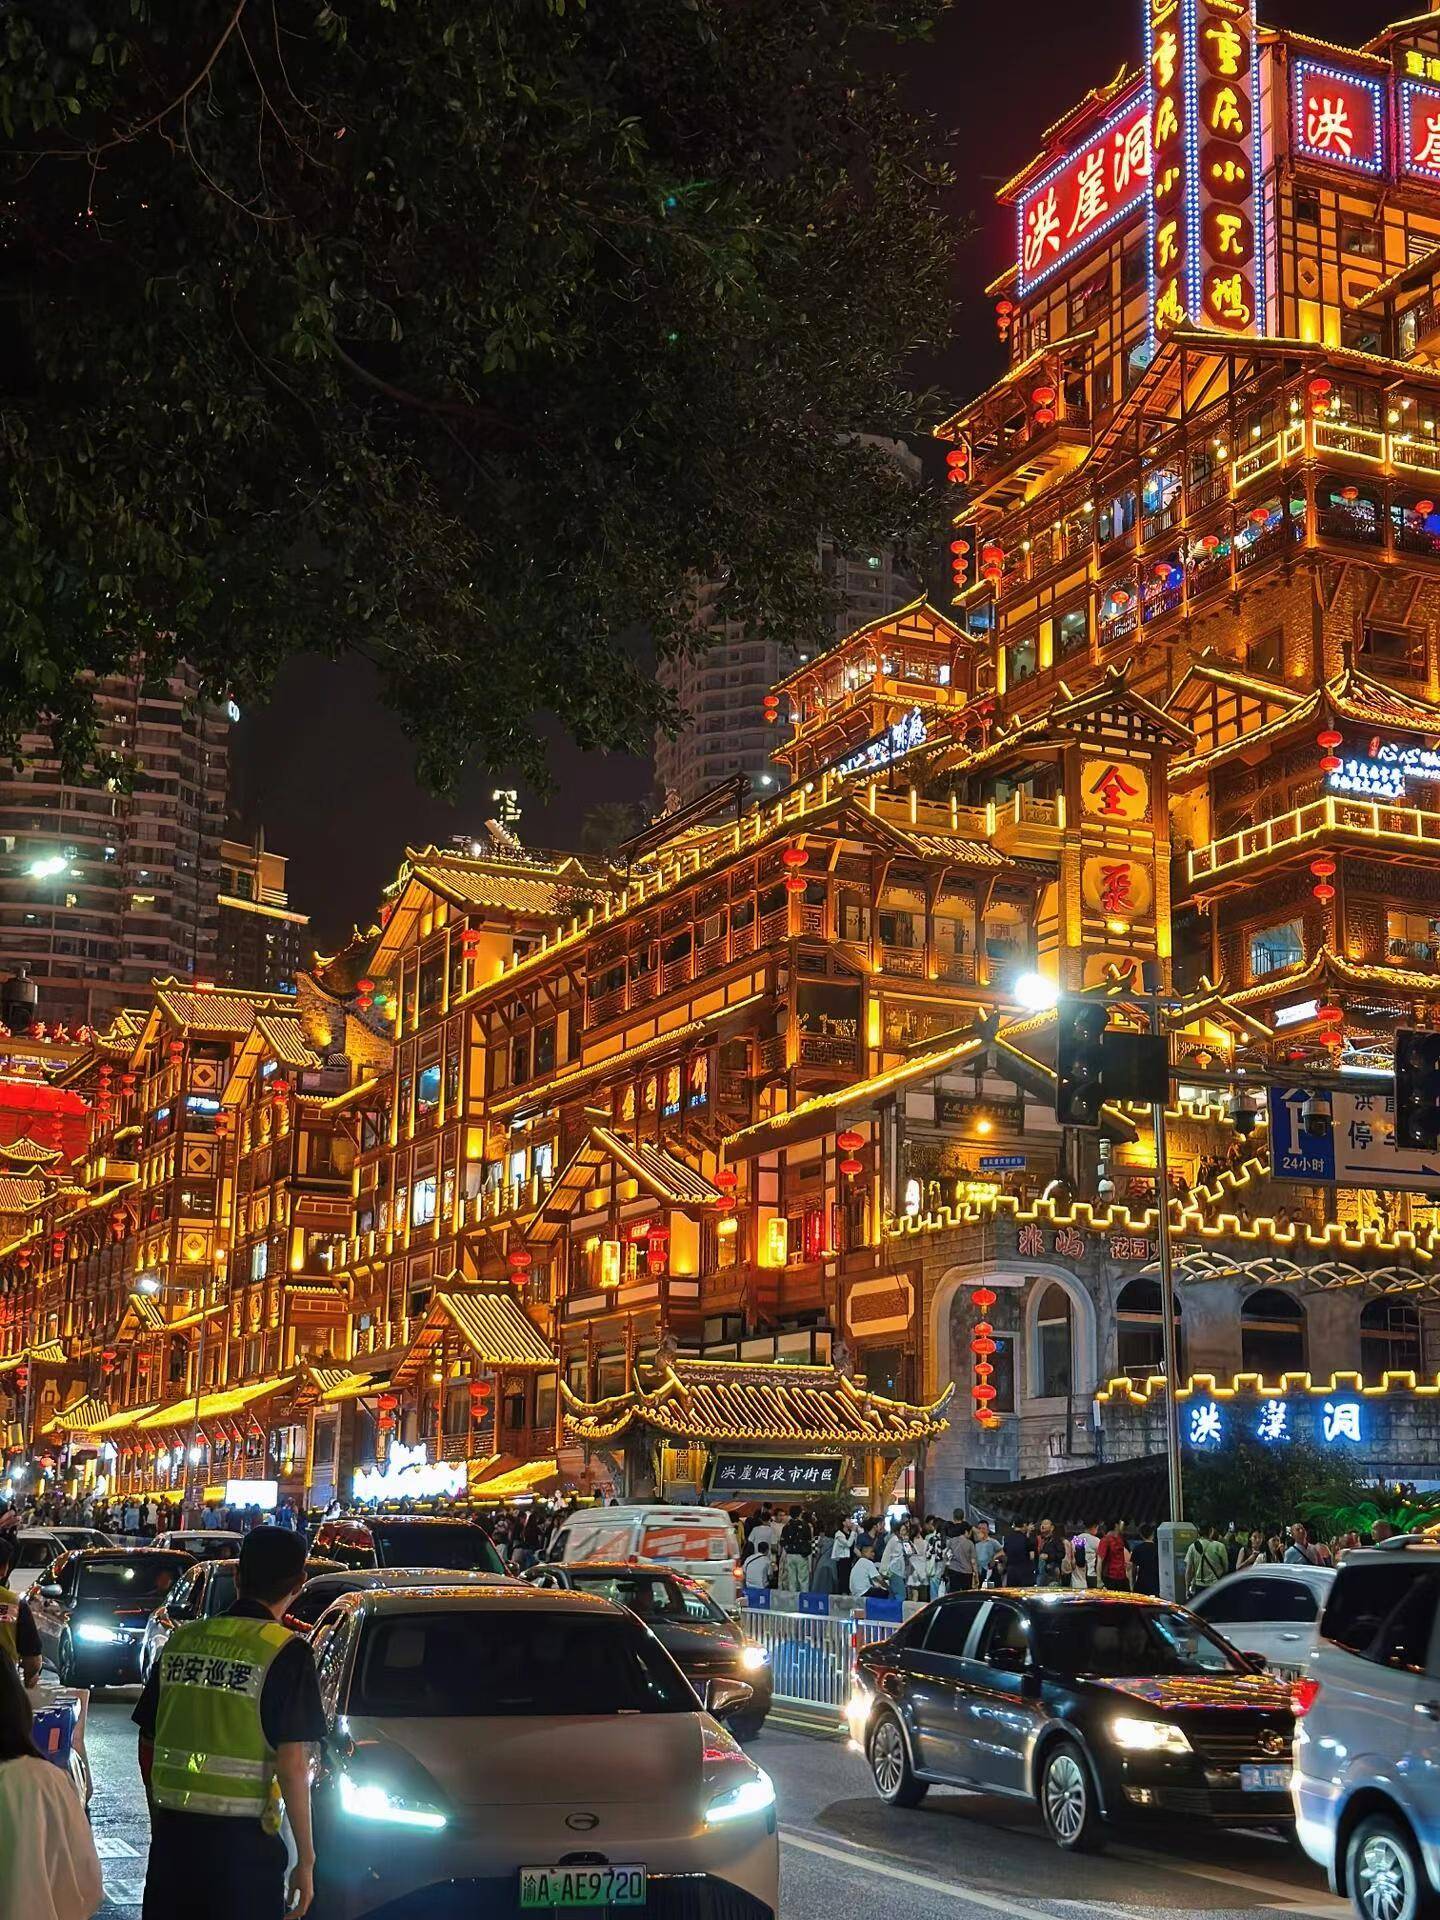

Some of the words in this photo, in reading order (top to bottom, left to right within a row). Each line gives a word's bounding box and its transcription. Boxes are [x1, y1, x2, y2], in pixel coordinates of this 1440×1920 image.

[1307, 97, 1353, 157] 洪
[1024, 115, 1150, 271] 洪崖洞
[1282, 1156, 1325, 1173] 24小时
[720, 1464, 832, 1483] 洪崖洞夜市街區
[167, 1656, 253, 1692] 治安巡逻
